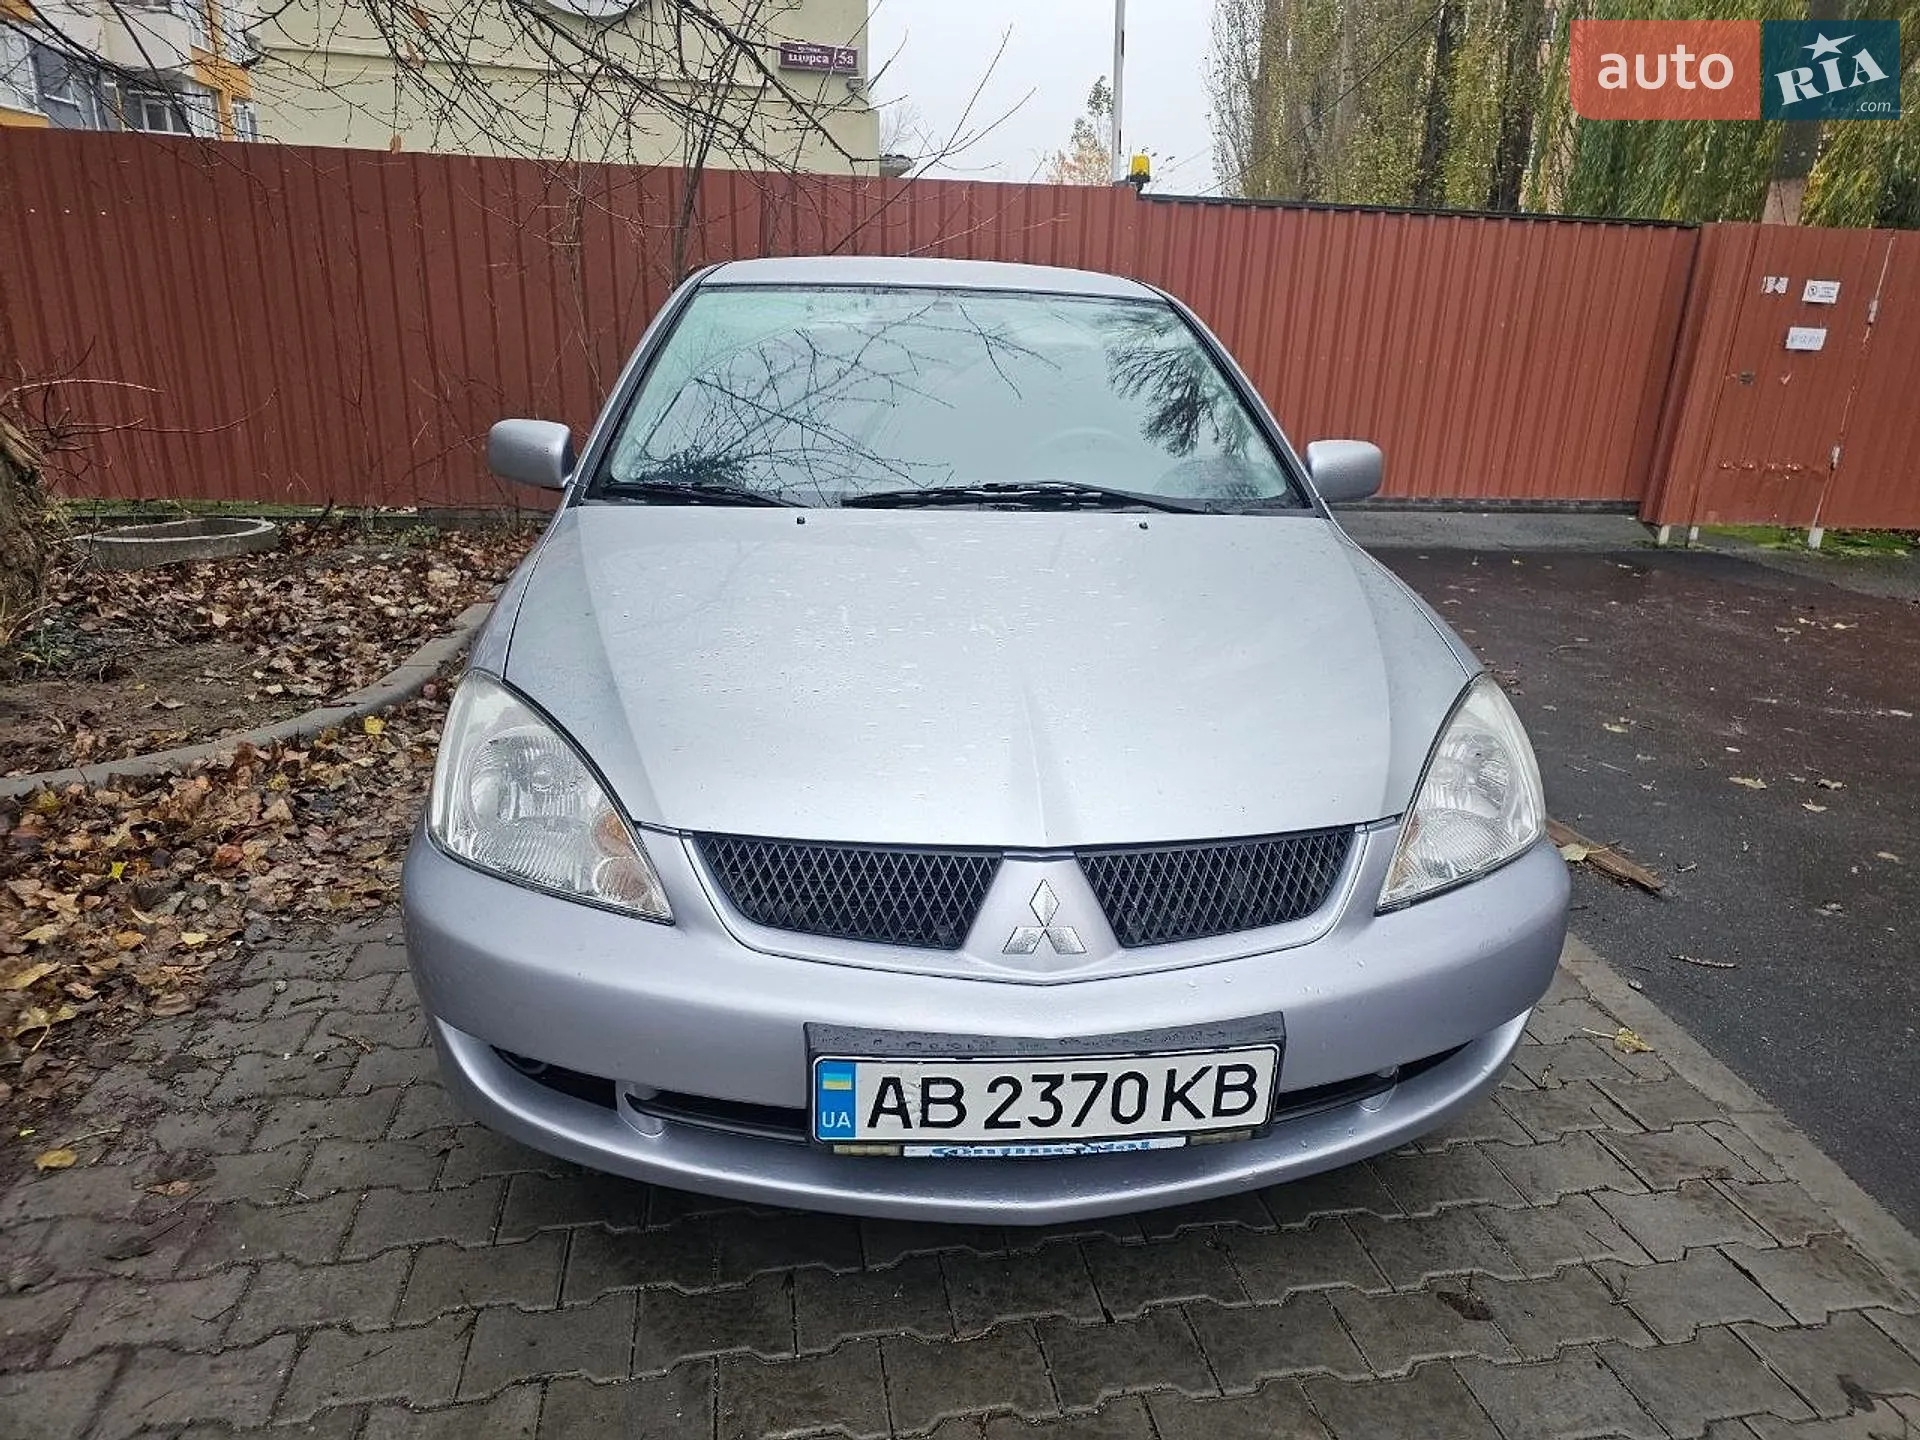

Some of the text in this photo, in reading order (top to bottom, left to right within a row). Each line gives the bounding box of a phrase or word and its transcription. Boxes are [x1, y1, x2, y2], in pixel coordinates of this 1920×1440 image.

[866, 1063, 1258, 1129] AB 2370 KB
[822, 1111, 851, 1128] UA
